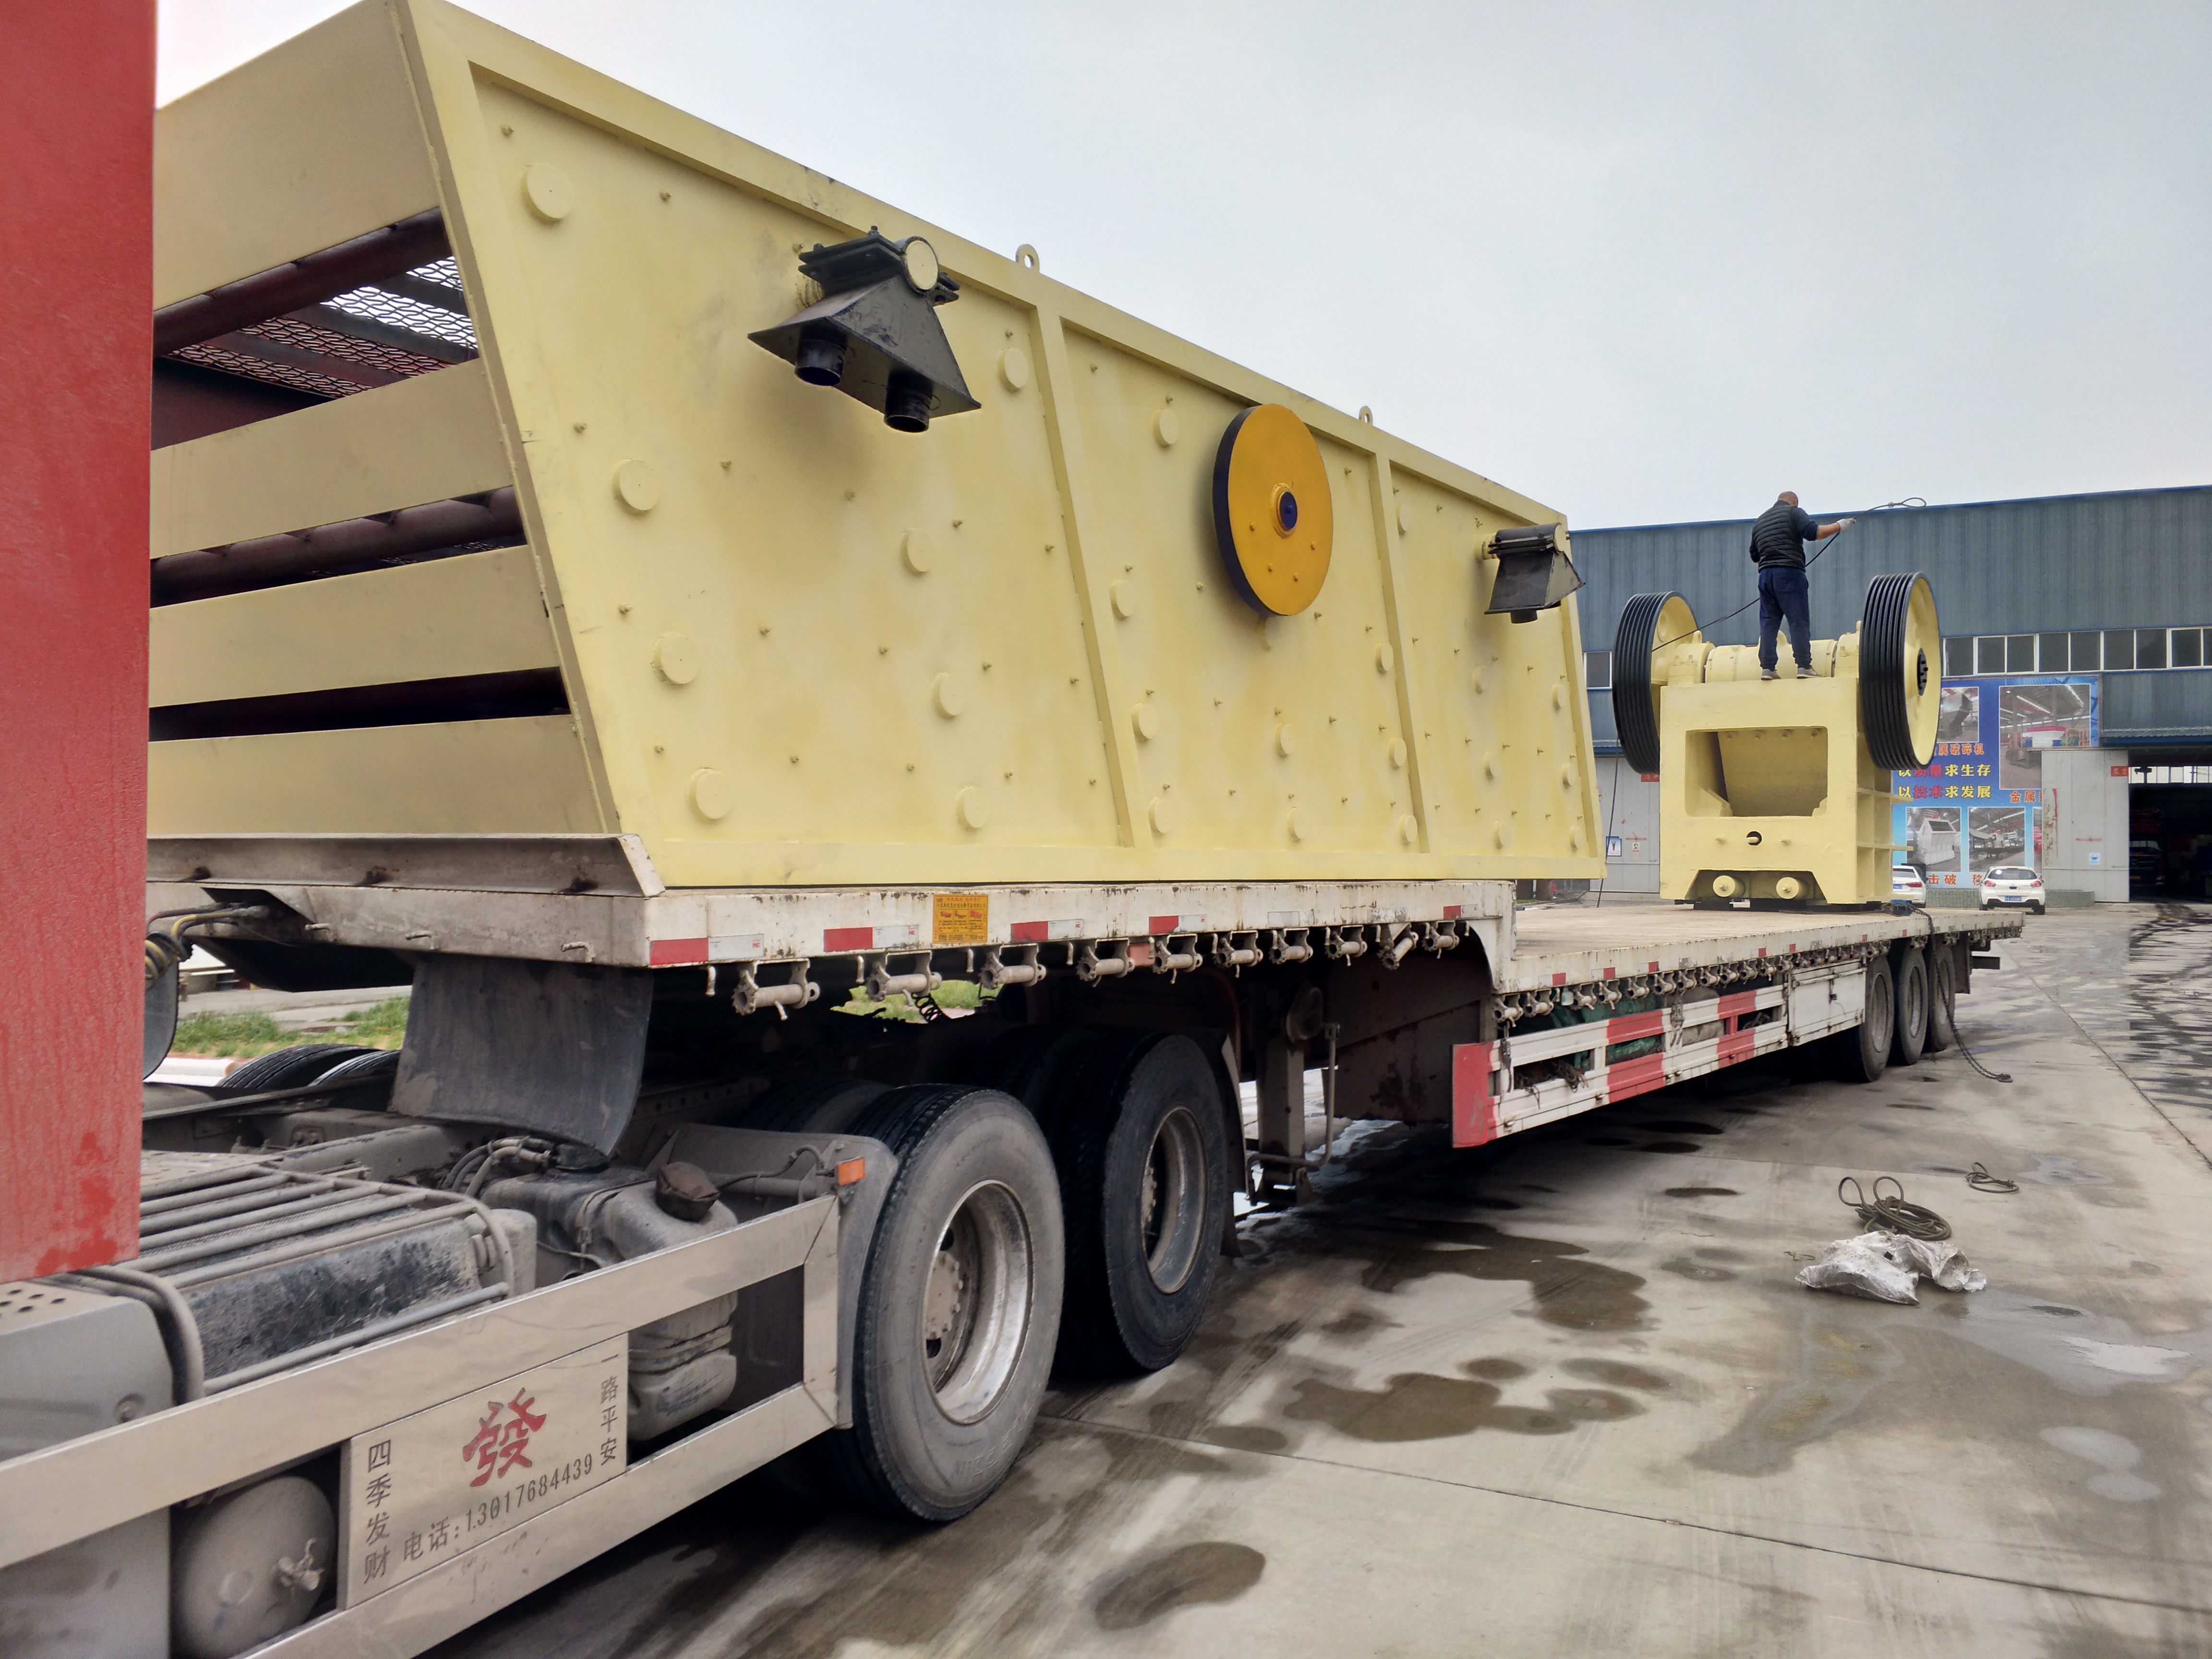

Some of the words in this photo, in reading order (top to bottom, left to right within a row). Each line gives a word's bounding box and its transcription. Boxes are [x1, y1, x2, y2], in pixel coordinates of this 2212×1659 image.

[1934, 744, 1984, 756] 属破碎机
[1898, 764, 1991, 777] 以质量求生存
[1898, 785, 1992, 799] 以技术求发展
[2009, 790, 2043, 803] 金属
[600, 1353, 619, 1467] 一路平安
[462, 1387, 547, 1487] 發
[364, 1439, 392, 1585] 四季发财
